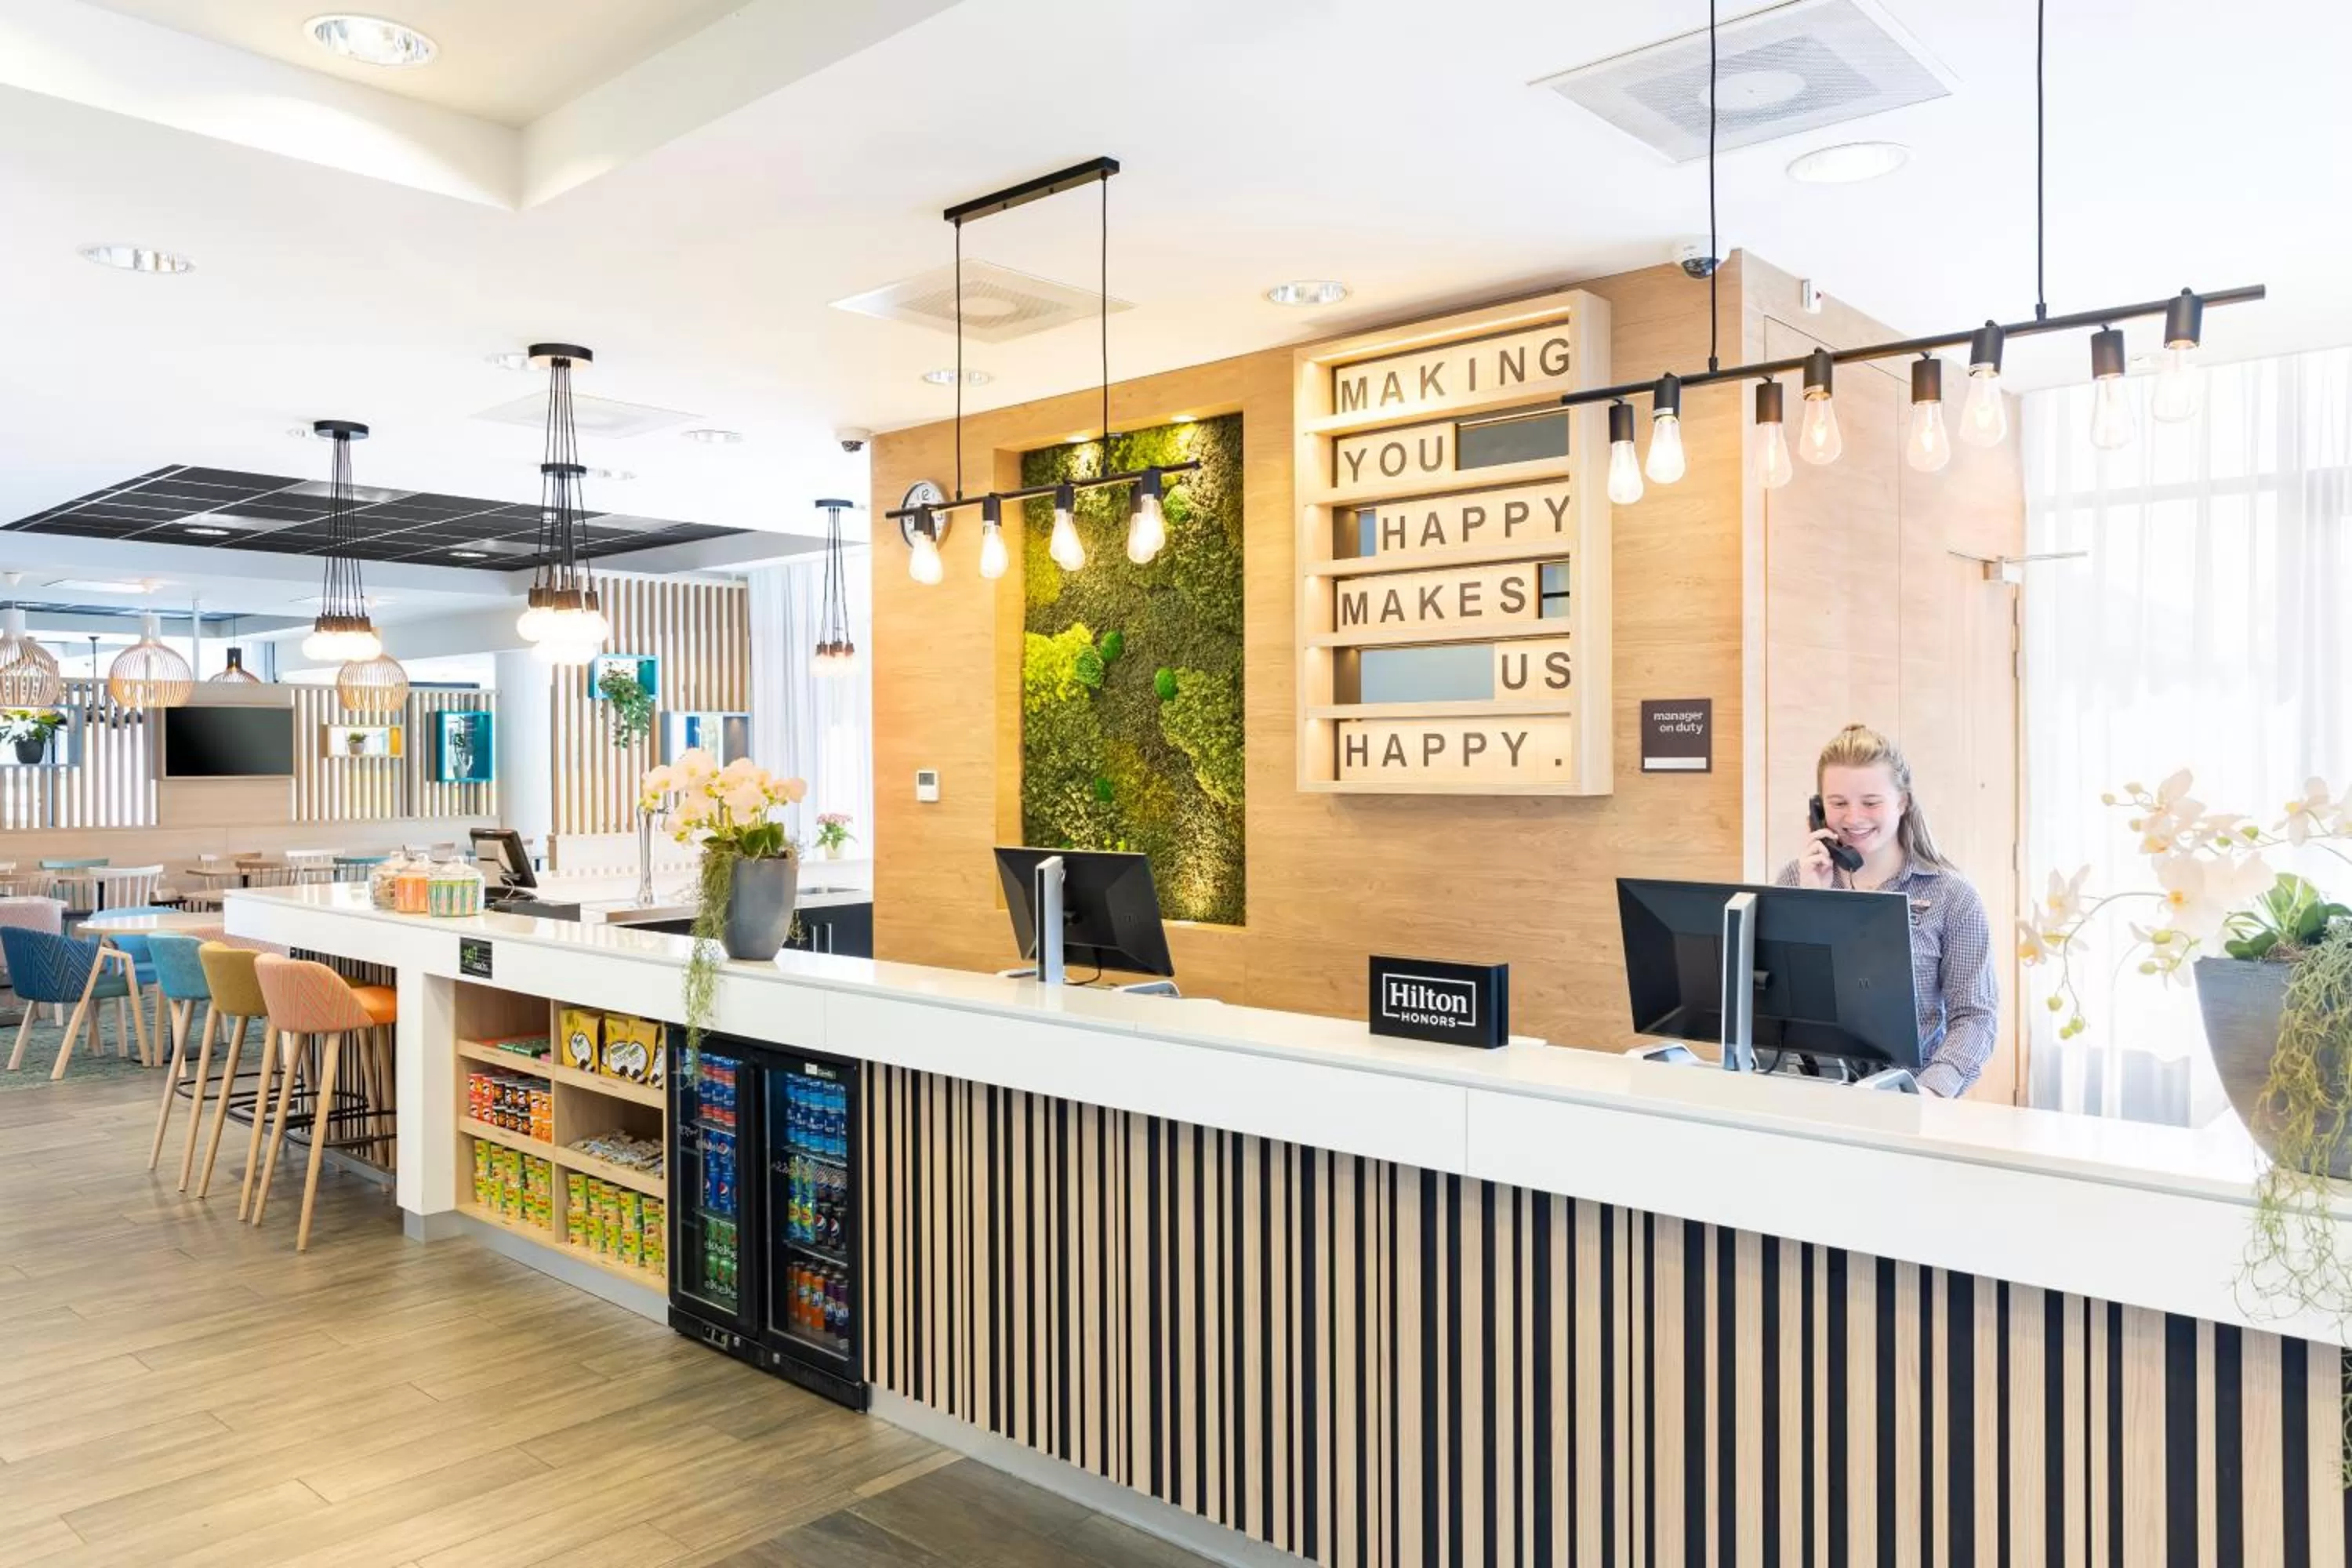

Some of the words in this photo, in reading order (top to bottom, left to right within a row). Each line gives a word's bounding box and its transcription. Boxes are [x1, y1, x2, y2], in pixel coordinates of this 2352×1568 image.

[1341, 338, 1571, 413] MAKING
[1344, 435, 1444, 484] YOU
[1382, 495, 1571, 550] HAPPY
[1341, 576, 1526, 626] MAKES
[1501, 652, 1571, 690] US
[1653, 712, 1703, 722] manager
[1660, 724, 1674, 732] on
[1676, 722, 1703, 735] duty
[1390, 982, 1468, 1014] Hilton
[1401, 1011, 1456, 1028] HONORS
